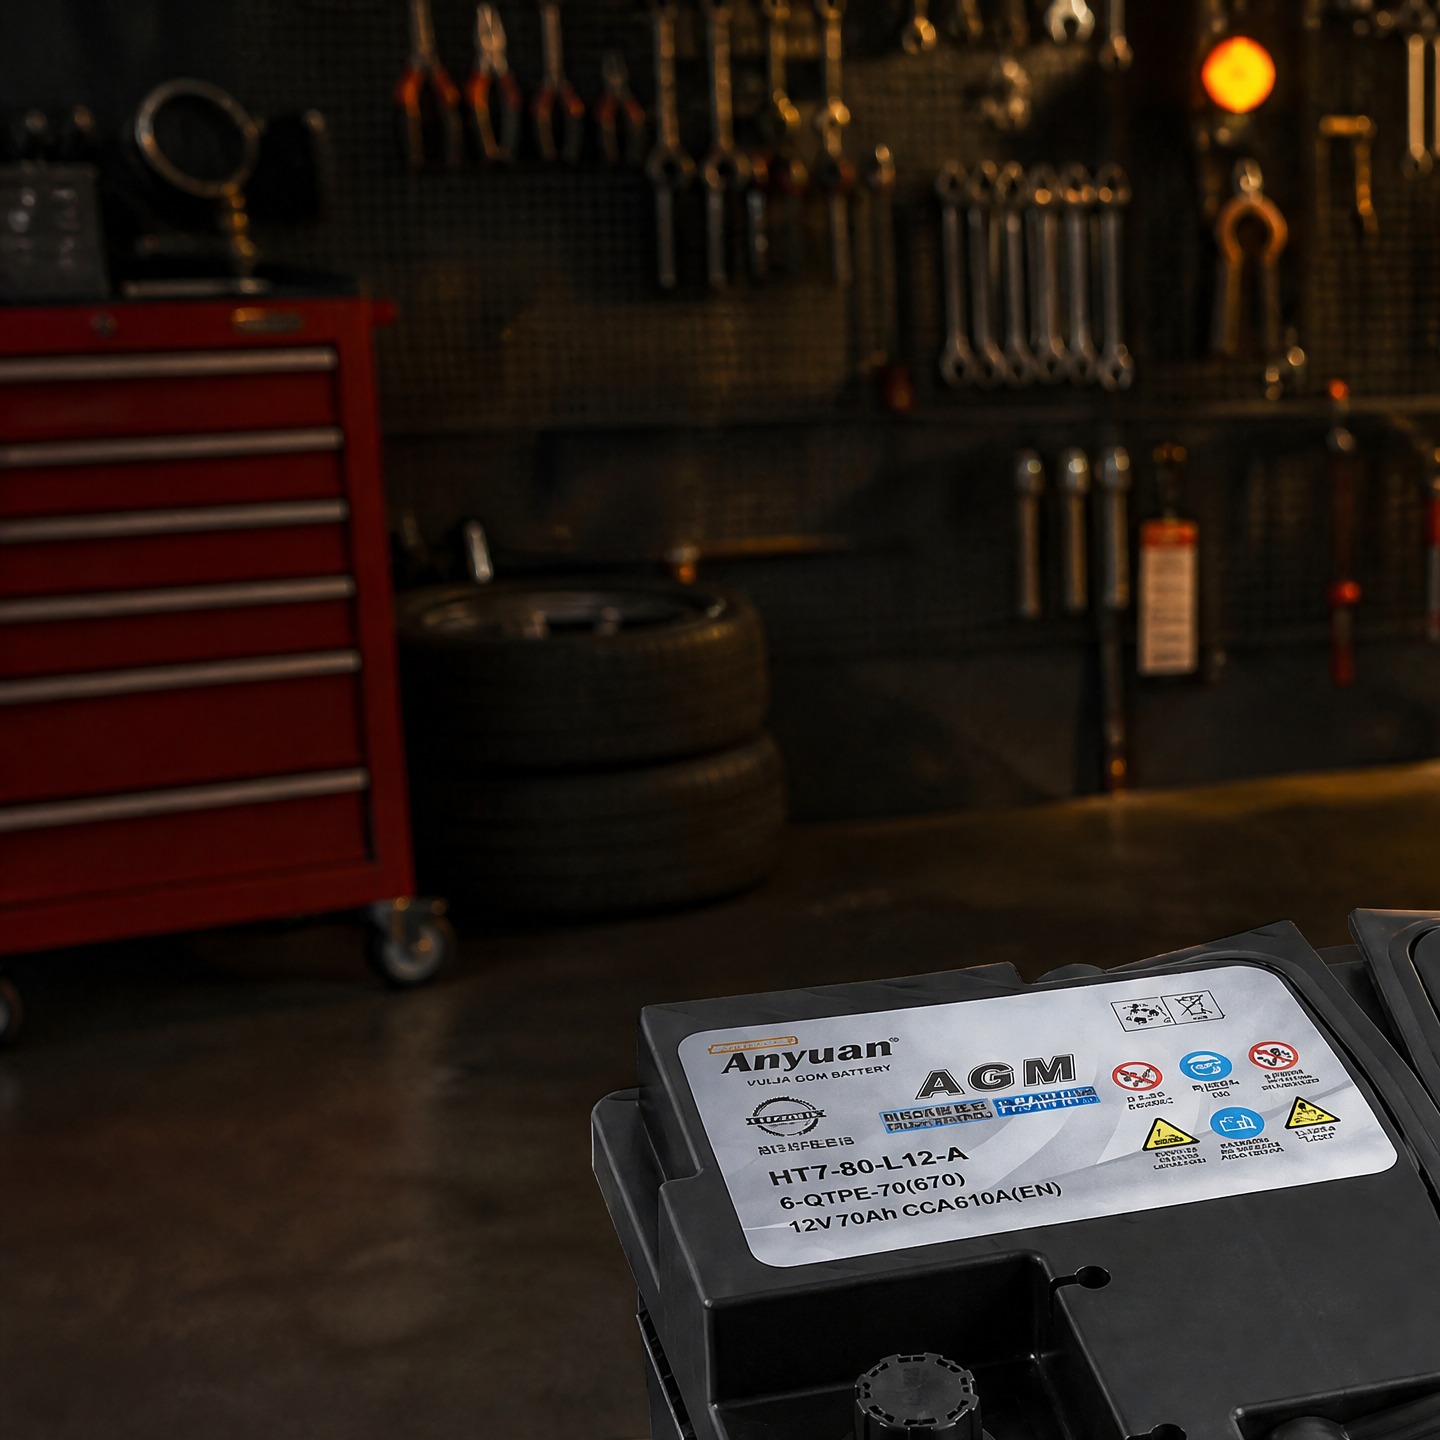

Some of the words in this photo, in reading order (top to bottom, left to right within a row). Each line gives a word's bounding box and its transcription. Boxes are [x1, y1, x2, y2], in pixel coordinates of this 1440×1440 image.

[721, 1038, 893, 1074] Anyuan
[832, 1064, 891, 1078] BATTERY
[915, 1053, 1077, 1100] AGM
[768, 1146, 969, 1186] HT7-80-L12-A
[780, 1172, 966, 1210] 6-QTPE-70(670)
[789, 1217, 832, 1233] 12V
[836, 1206, 897, 1226] 70Ah
[902, 1181, 1062, 1218] CCA610A(EN)
